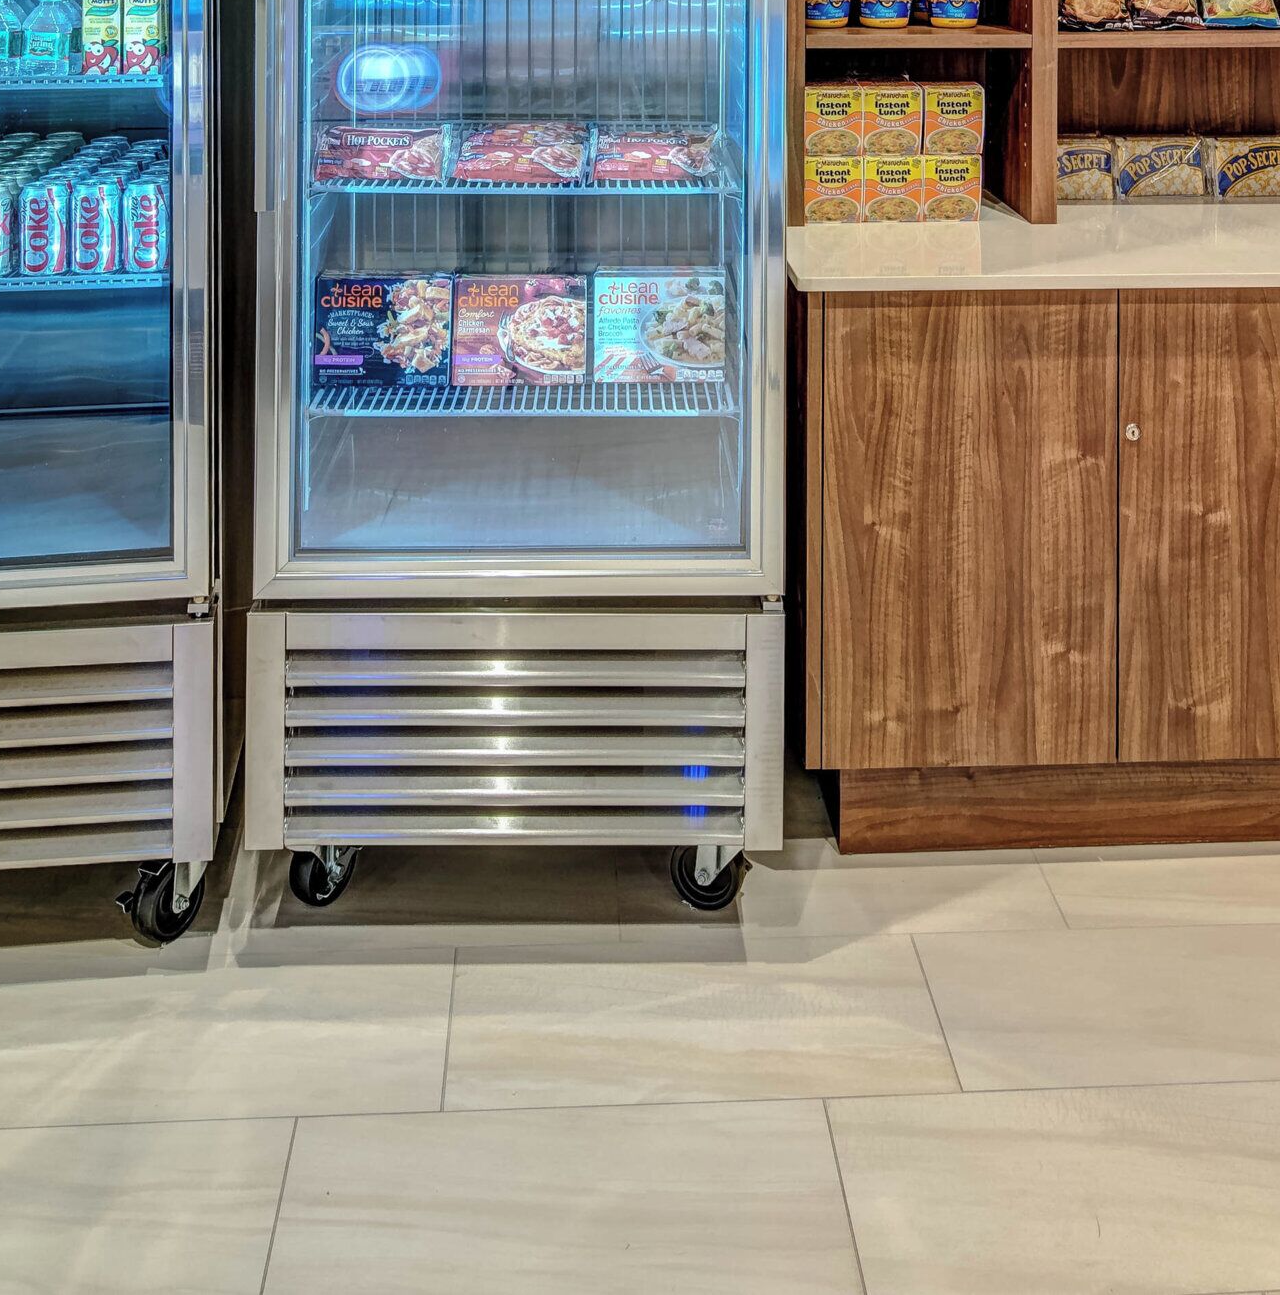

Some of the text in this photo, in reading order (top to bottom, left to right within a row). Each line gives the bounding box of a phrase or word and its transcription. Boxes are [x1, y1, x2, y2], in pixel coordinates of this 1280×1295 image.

[816, 101, 852, 109] Instant
[875, 101, 910, 109] Instant
[936, 100, 972, 108] Instant
[820, 108, 848, 116] Lunch
[879, 108, 906, 116] Lunch
[940, 107, 968, 115] Lunch
[817, 118, 845, 128] Chicken
[875, 117, 904, 127] Chicken
[937, 116, 967, 126] Chicken
[345, 134, 410, 147] HOT POCKETS
[1063, 153, 1108, 170] SECRET
[815, 169, 851, 177] Instant
[876, 168, 911, 176] Instant
[935, 167, 970, 175] Instant
[1225, 160, 1249, 182] POP
[819, 176, 847, 184] Lunch
[880, 175, 908, 183] Lunch
[938, 174, 966, 182] Lunch
[816, 185, 845, 195] Chicken
[876, 184, 905, 195] Chicken
[935, 183, 964, 193] Chicken
[23, 197, 49, 273] Coke
[74, 195, 100, 271] Coke
[133, 194, 160, 270] Coke
[329, 310, 373, 318] MARKETPLACE
[458, 308, 495, 320] Comfort
[598, 305, 641, 316] favorites
[327, 319, 349, 327] Sweet
[336, 326, 365, 335] Chicken
